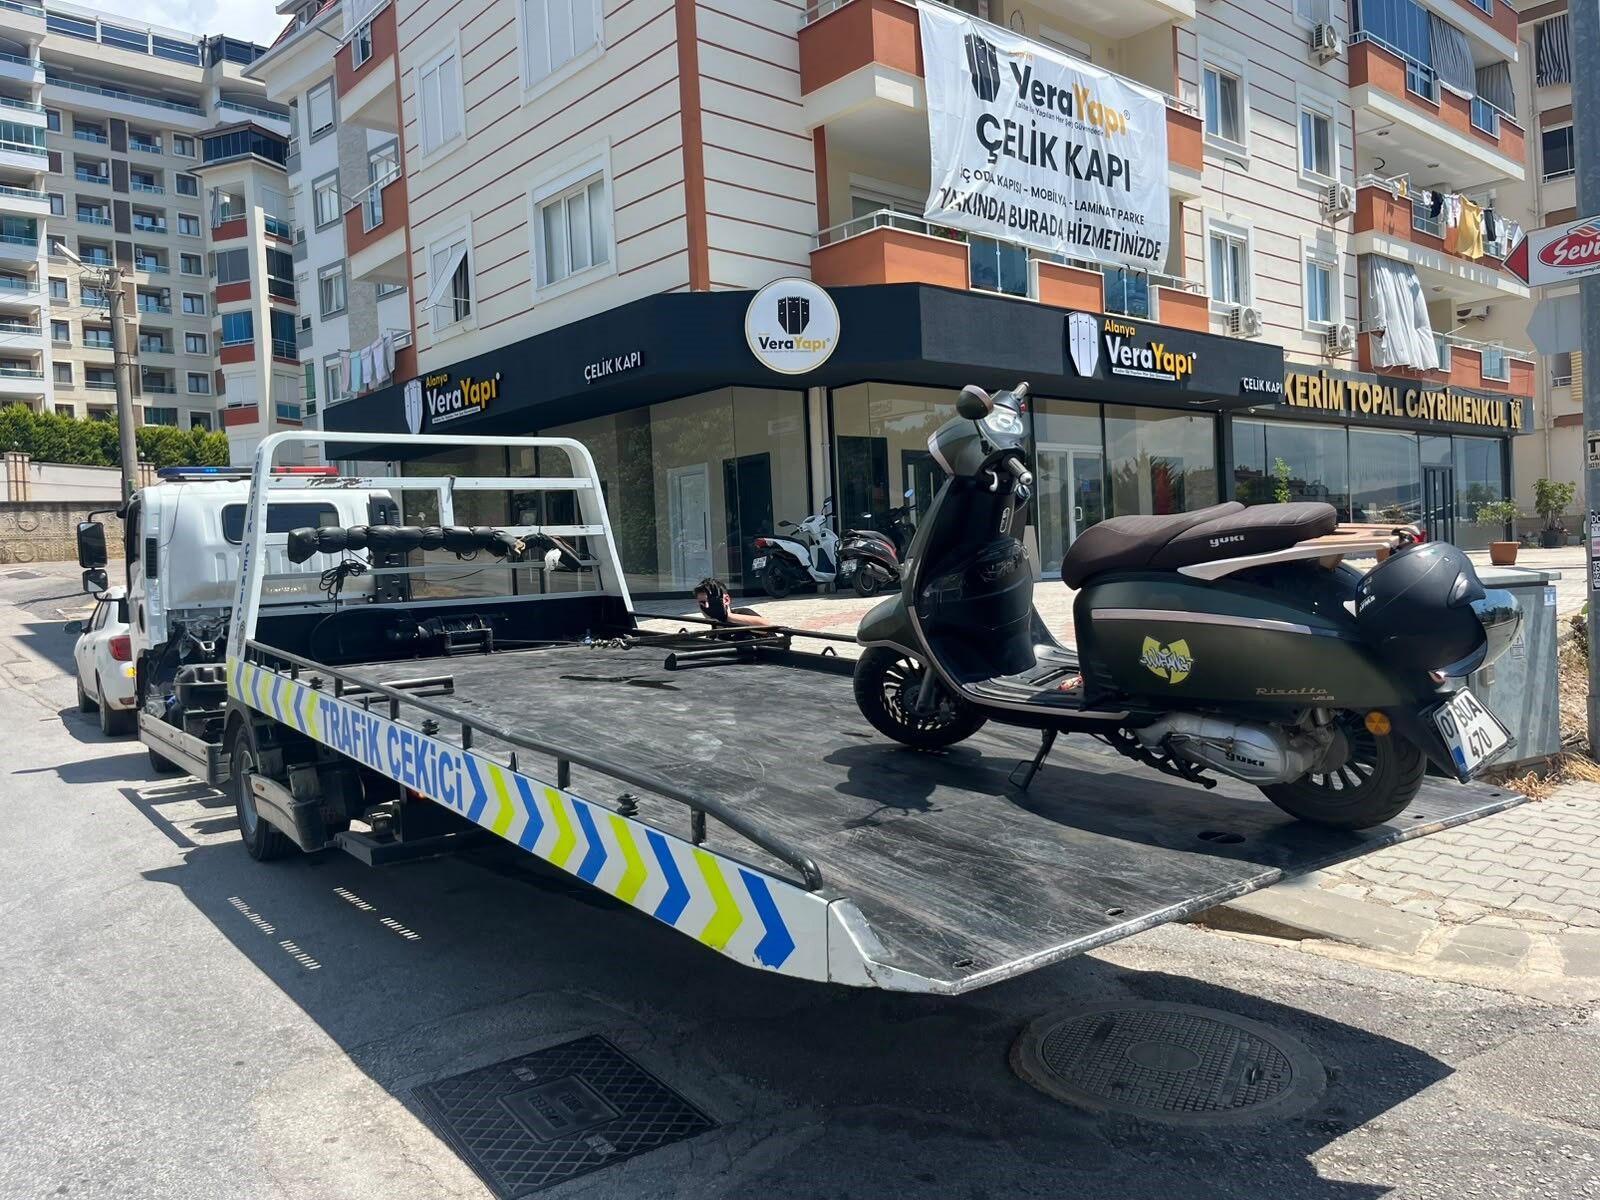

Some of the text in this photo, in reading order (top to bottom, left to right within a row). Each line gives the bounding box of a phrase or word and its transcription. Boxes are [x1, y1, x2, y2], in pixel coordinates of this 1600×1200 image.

[976, 113, 1131, 192] ÇELİK KAPI
[973, 168, 995, 186] ODA
[997, 174, 1022, 195] KAPISI
[1031, 185, 1067, 207] MOBİLYA
[1074, 199, 1116, 218] LAMİNAT
[1117, 208, 1145, 226] PARKE
[939, 186, 1161, 262] YAKINDA BURADA HİZMETİNİZDE
[1104, 319, 1136, 338] Alanya
[584, 351, 641, 385] ÇELİK KAPI
[1105, 334, 1193, 381] VeraYapı
[425, 373, 449, 389] Alanya
[426, 377, 497, 416] VeraYapı
[1243, 376, 1283, 394] ÇELİK KAPI
[1284, 369, 1344, 411] KERİM
[1346, 381, 1404, 417] TOPAL
[1440, 695, 1483, 739] 07 BUA
[1468, 726, 1493, 759] 470
